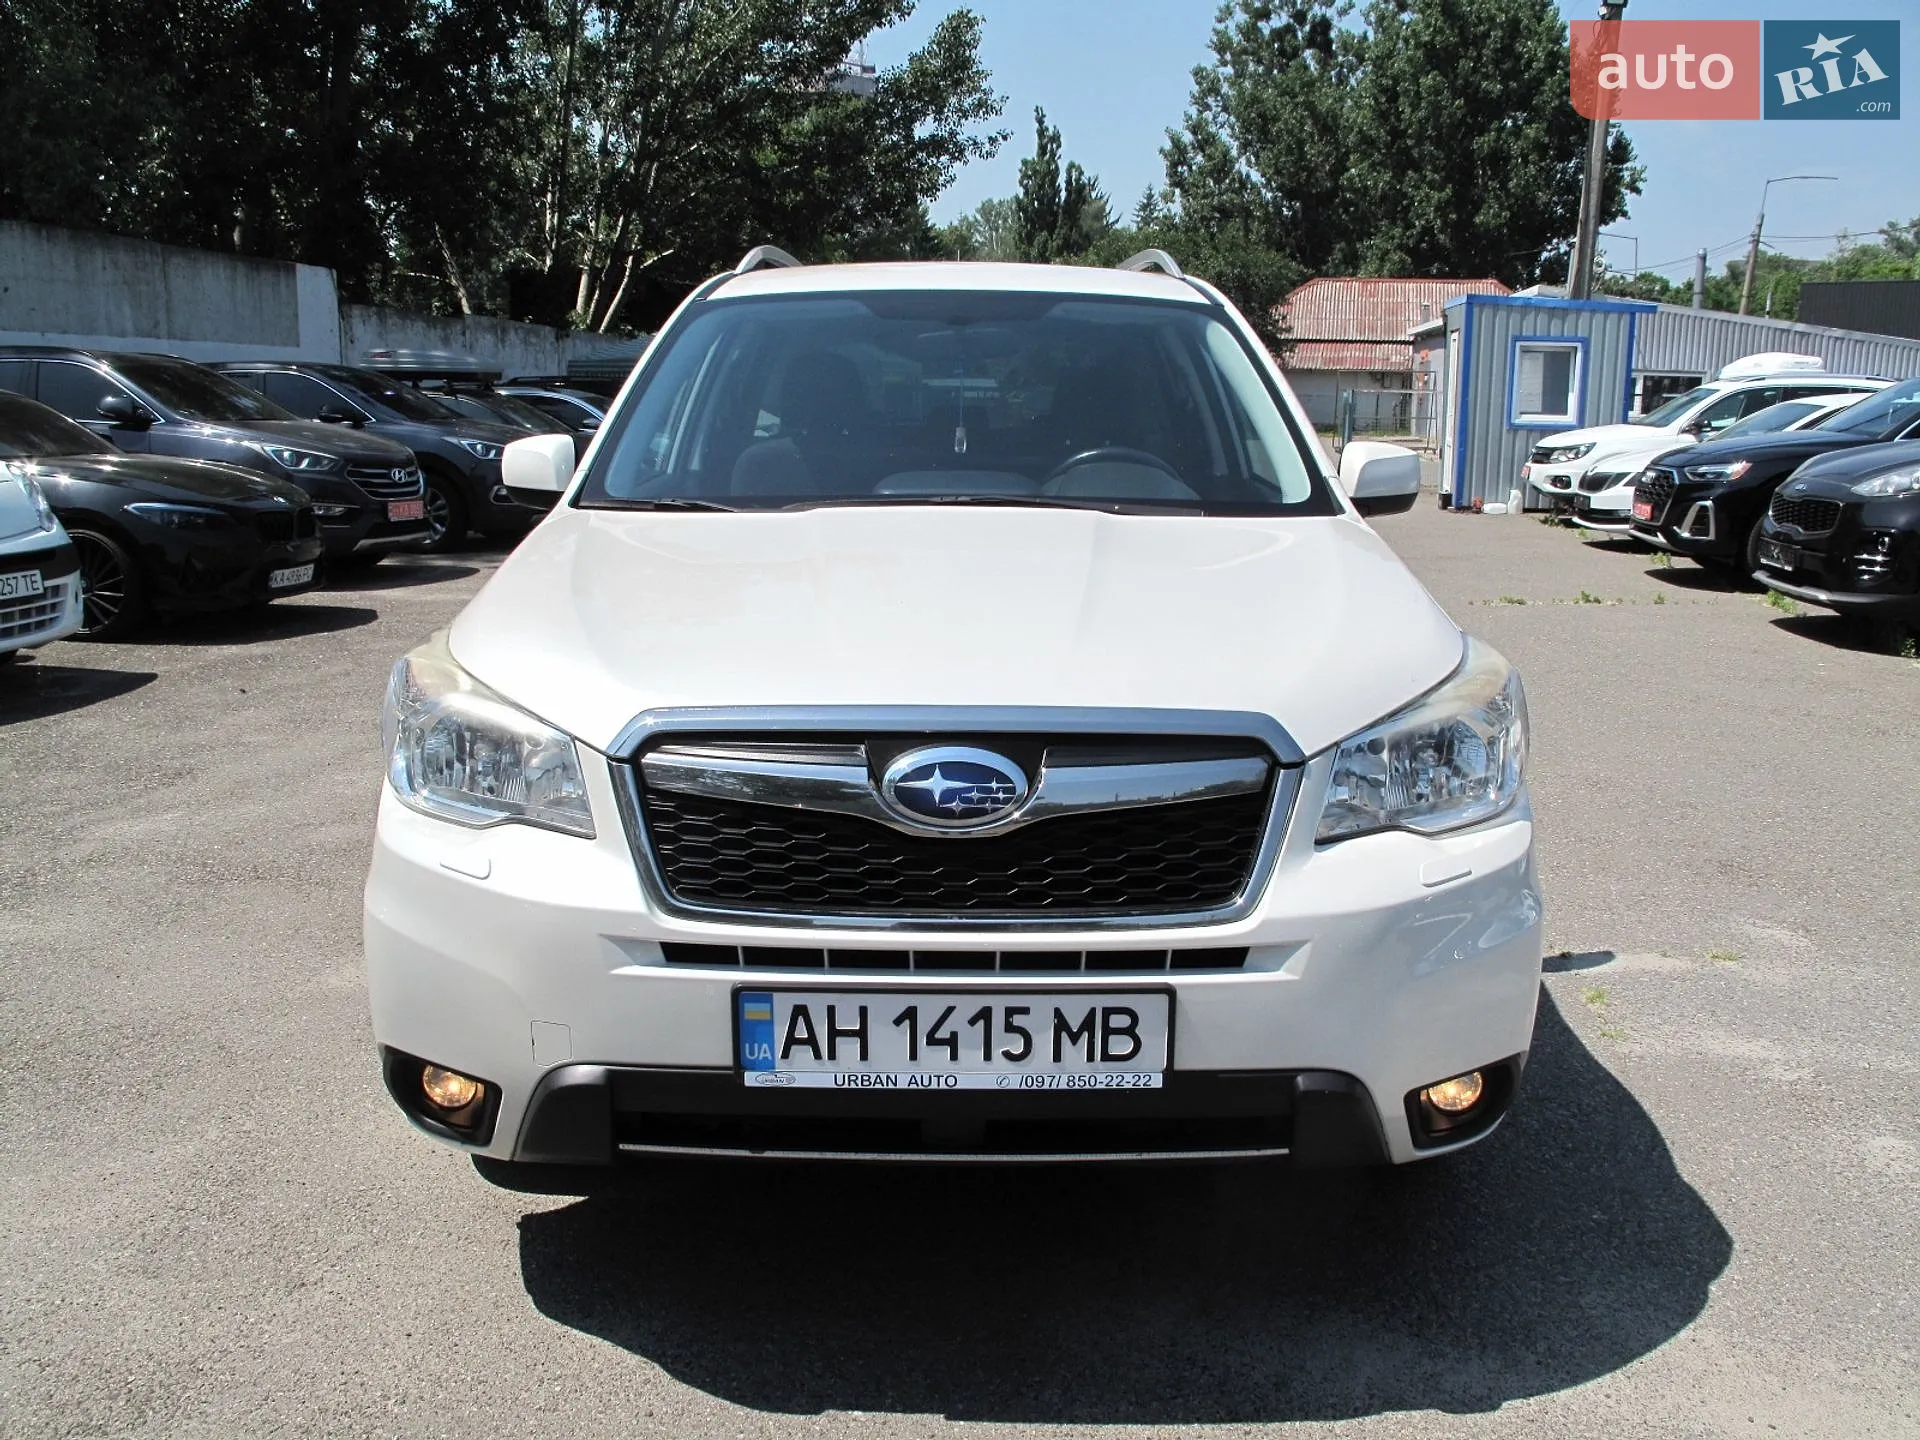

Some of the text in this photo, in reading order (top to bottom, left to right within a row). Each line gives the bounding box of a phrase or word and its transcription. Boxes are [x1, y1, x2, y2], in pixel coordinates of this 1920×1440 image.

[21, 573, 40, 593] TE
[780, 1004, 1143, 1063] AH 1415 MB
[745, 1042, 773, 1060] UA
[833, 1073, 898, 1087] URBAN
[907, 1074, 958, 1088] AUTO
[1066, 1074, 1152, 1088] 850-22-22
